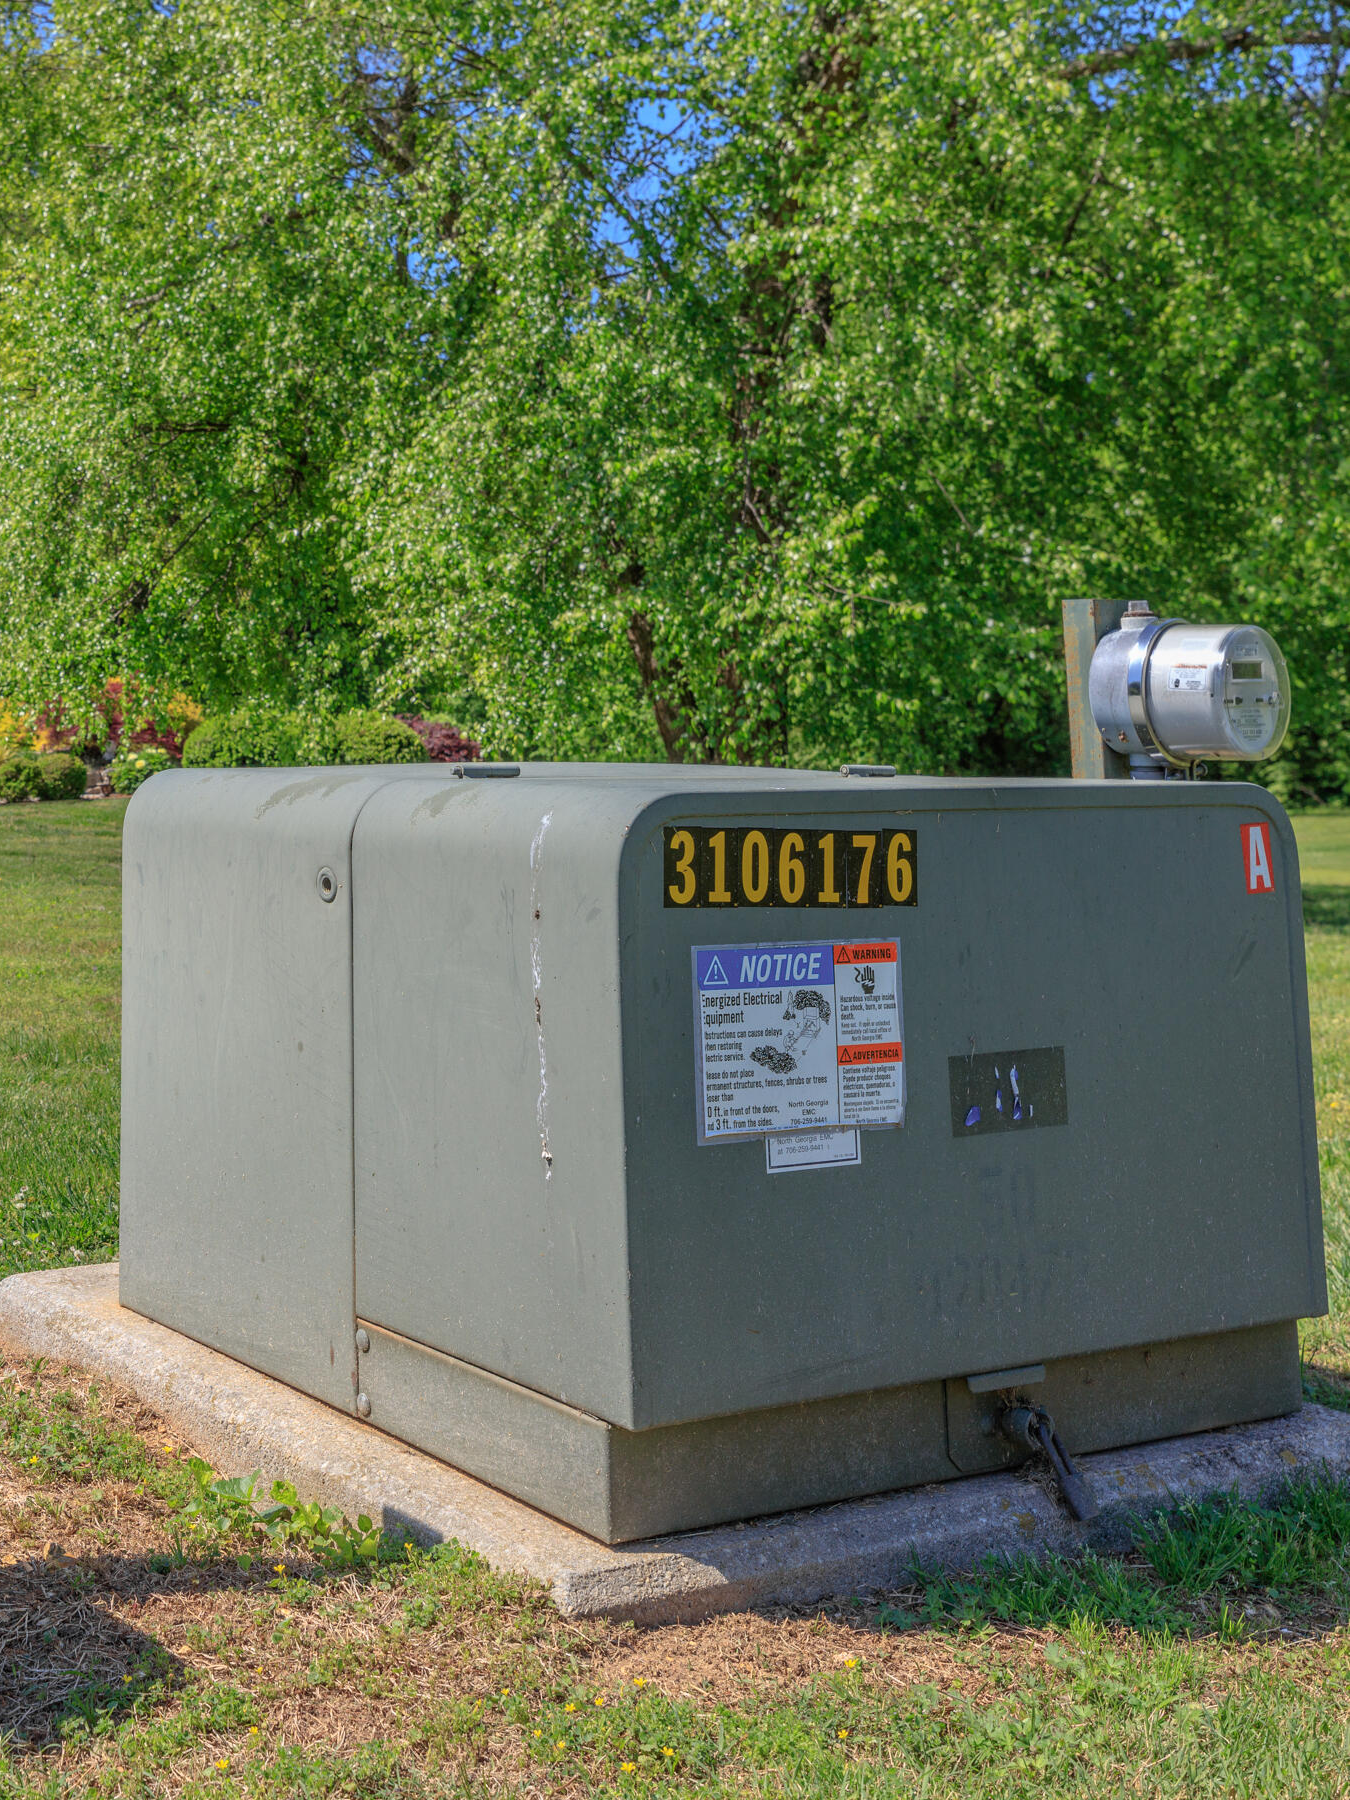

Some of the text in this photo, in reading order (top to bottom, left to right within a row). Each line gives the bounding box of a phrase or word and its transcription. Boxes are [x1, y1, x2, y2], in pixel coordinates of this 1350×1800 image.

[1249, 825, 1272, 890] A
[668, 830, 913, 904] 3106176
[852, 948, 891, 960] WARNING
[739, 952, 822, 983] NOTICE
[743, 990, 783, 1006] Electrical
[705, 1030, 736, 1040] bstructions
[748, 1030, 764, 1038] cause
[765, 1028, 783, 1039] delays
[718, 1041, 743, 1052] restoring
[706, 1052, 746, 1062] lectric service.
[853, 1048, 899, 1060] ADVERTENCIA
[706, 1068, 755, 1080] lease do not place
[706, 1082, 732, 1091] ermanent
[733, 1080, 764, 1090] structures,
[764, 1078, 785, 1088] fences,
[786, 1076, 805, 1086] shrubs
[812, 1076, 828, 1084] trees
[706, 1093, 734, 1102] loser than
[788, 1100, 829, 1108] North Georgia
[707, 1104, 780, 1118] 0 ft. in front of the doors,
[802, 1108, 816, 1116] EMC
[716, 1119, 721, 1131] 3
[722, 1118, 732, 1130] ft.
[733, 1119, 746, 1129] from
[748, 1118, 757, 1128] the
[758, 1117, 774, 1126] sides.
[790, 1117, 828, 1126] 706-259-9441
[777, 1137, 793, 1145] North
[794, 1136, 818, 1144] Georgia
[786, 1144, 824, 1154] 706-259-9441
